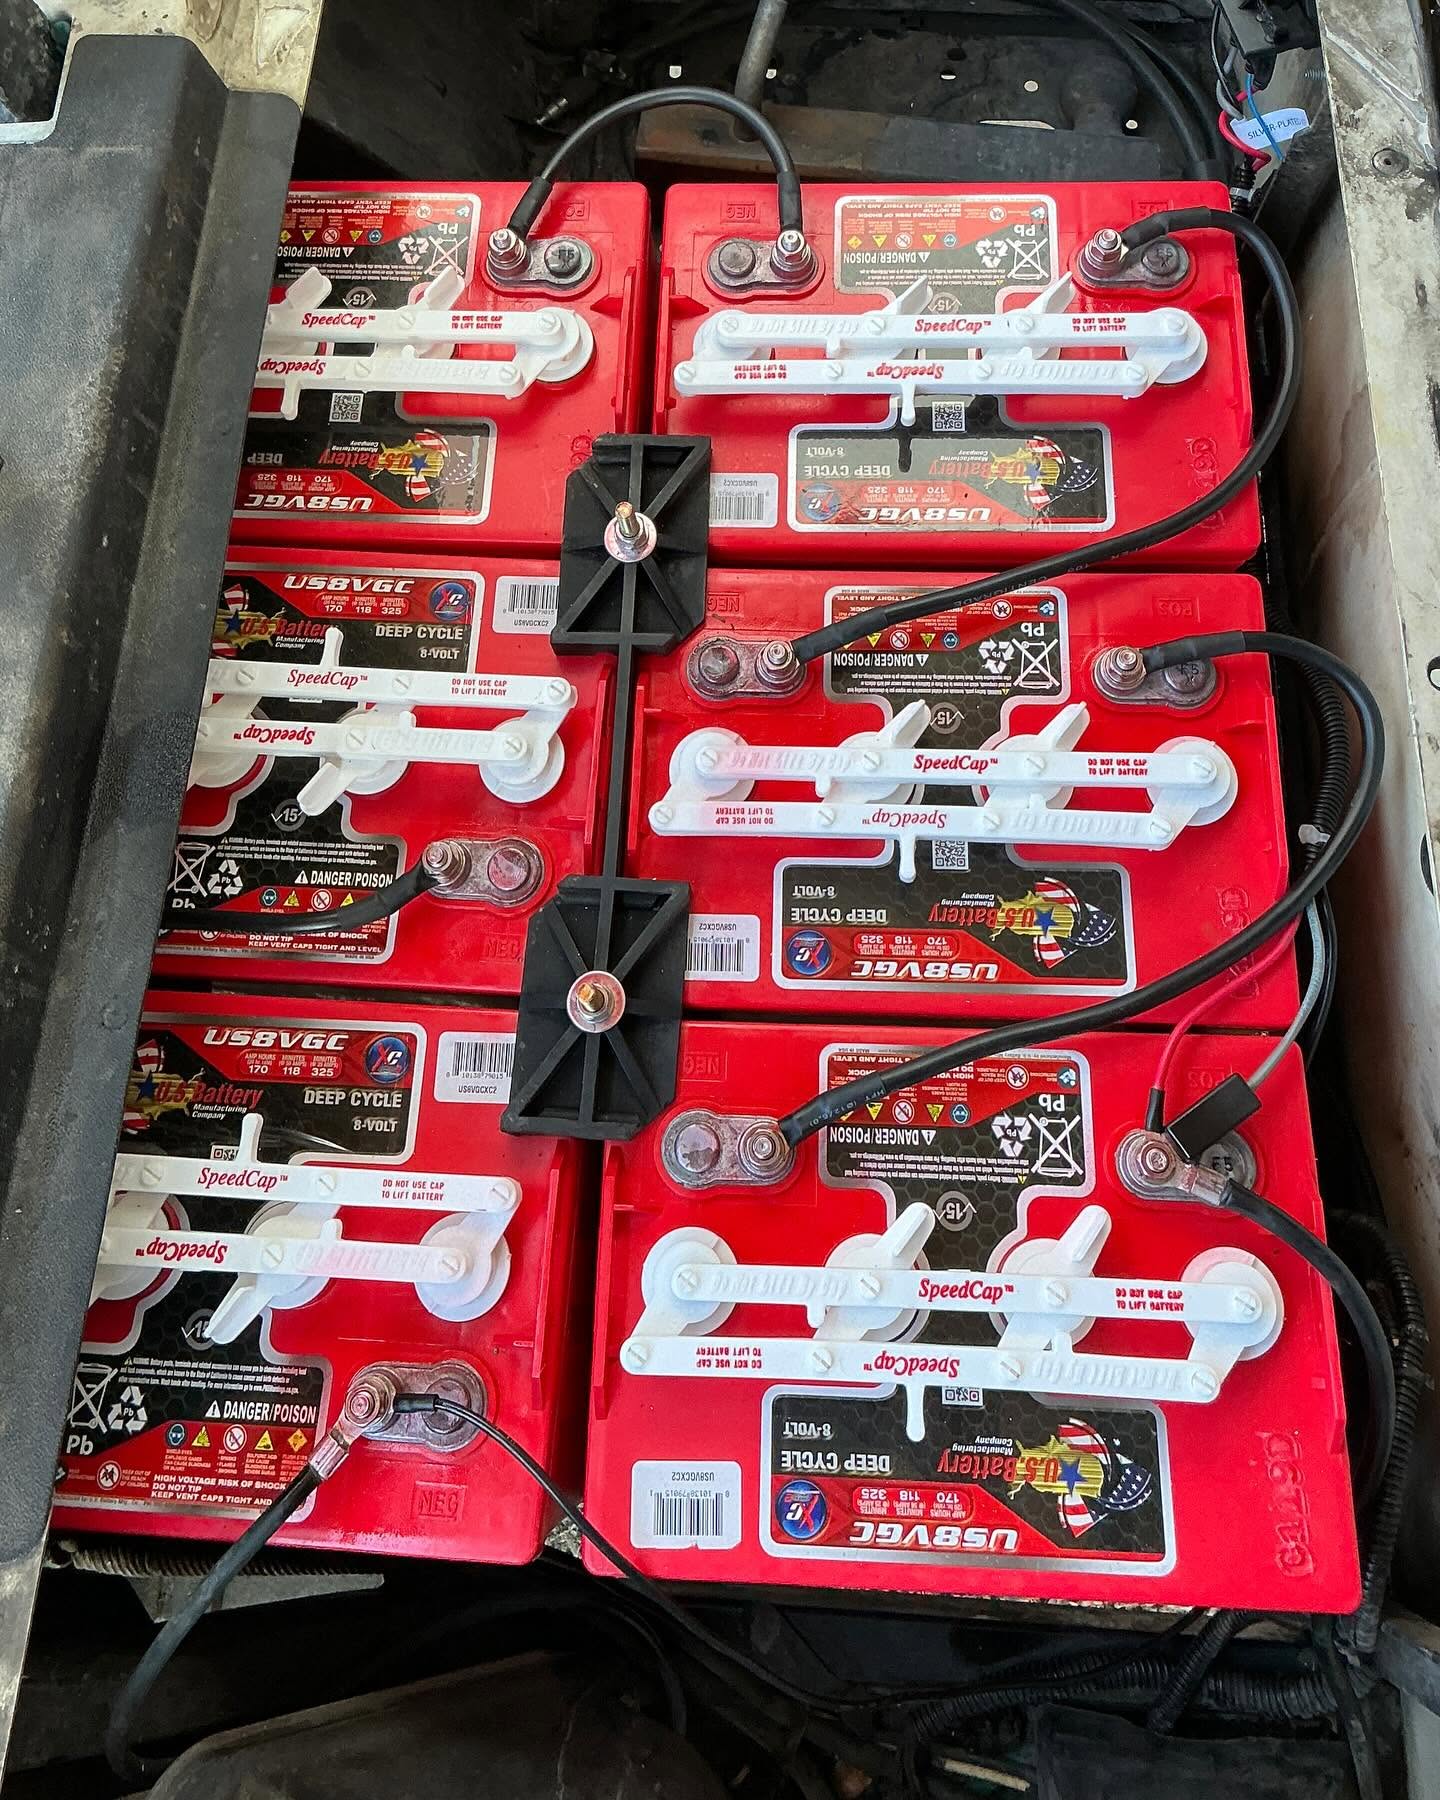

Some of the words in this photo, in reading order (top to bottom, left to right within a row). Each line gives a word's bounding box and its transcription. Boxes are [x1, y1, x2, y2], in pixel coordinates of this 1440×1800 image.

[438, 223, 458, 234] Pb
[1014, 224, 1035, 236] Pb
[277, 246, 340, 256] DANGER/POISO
[843, 251, 916, 263] DANGER/POISON
[353, 294, 365, 305] 15
[805, 446, 845, 457] 8-VOLT
[247, 452, 283, 465] DEEP
[318, 449, 379, 469] Battery
[804, 465, 849, 476] CYCLE
[854, 465, 890, 477] DEEP
[928, 459, 990, 477] Battery
[315, 475, 332, 483] 170
[244, 494, 372, 510] US8VGC
[857, 507, 991, 520] US8VGC
[284, 575, 415, 594] US8VGC
[325, 605, 343, 613] 170
[355, 606, 371, 614] 118
[382, 607, 402, 615] 325
[707, 597, 740, 612] NEG
[1158, 601, 1192, 616] POS
[376, 625, 414, 637] DEEP
[416, 627, 462, 640] CYCLE
[1020, 622, 1044, 636] Pb
[276, 636, 324, 645] Manufacturing
[420, 648, 460, 659] 8-VOLT
[834, 653, 913, 666] DANGER/POISON
[715, 807, 745, 815] BATTERY
[793, 885, 835, 897] 8-VOLT
[961, 892, 994, 900] Company
[941, 899, 994, 907] Manufacturing
[791, 907, 841, 922] CYCLE
[845, 908, 886, 923] DEEP
[928, 905, 998, 927] Battery
[861, 935, 883, 944] 325
[895, 936, 912, 944] 118
[927, 936, 947, 945] 170
[851, 960, 998, 980] US8VGC
[203, 1029, 350, 1050] US8VGC
[249, 1065, 268, 1074] 170
[282, 1066, 301, 1075] 118
[311, 1068, 334, 1077] 325
[192, 1082, 264, 1108] Battery
[304, 1089, 346, 1105] DEEP
[350, 1090, 402, 1108] CYCLE
[1038, 1093, 1065, 1111] Pb
[193, 1104, 247, 1114] Manufacturing
[192, 1111, 226, 1120] Company
[354, 1119, 398, 1132] 8-VOLT
[830, 1127, 919, 1144] DANGER/POISON
[395, 1180, 409, 1188] NOT
[412, 1181, 426, 1189] USE
[430, 1182, 444, 1190] CAP
[393, 1191, 409, 1200] LIFT
[412, 1192, 444, 1201] BATTERY
[945, 1202, 960, 1219] 15
[696, 1346, 729, 1356] BATTERY
[732, 1347, 750, 1356] LIFT
[752, 1348, 762, 1356] TO
[696, 1358, 711, 1368] CAP
[715, 1358, 730, 1368] USE
[734, 1359, 749, 1368] NOT
[752, 1359, 762, 1369] DO
[223, 1401, 317, 1425] DANGER/POISON
[783, 1421, 831, 1438] 8-VOLT
[66, 1434, 94, 1456] Pb
[975, 1435, 1013, 1447] Company
[952, 1443, 1013, 1456] Manufacturing
[781, 1450, 838, 1470] CYCLE
[844, 1454, 890, 1472] DEEP
[936, 1448, 1017, 1483] Battery
[154, 1474, 178, 1482] HIGH
[180, 1475, 216, 1485] VOLTAGE
[218, 1478, 239, 1486] RISK
[241, 1480, 253, 1488] OF
[255, 1481, 286, 1490] SHOCK
[671, 1472, 714, 1481] US8VGCXC2
[153, 1483, 165, 1491] DO
[167, 1484, 186, 1492] NOT
[151, 1491, 174, 1499] KEEP
[201, 1494, 224, 1502] CAPS
[226, 1496, 252, 1504] TIGHT
[254, 1498, 272, 1506] AND
[861, 1488, 887, 1500] 325
[900, 1490, 920, 1502] 118
[937, 1492, 960, 1504] 170
[419, 1491, 459, 1514] NEG
[860, 1506, 888, 1514] MINUTES
[896, 1508, 923, 1516] MINUTES
[930, 1509, 950, 1517] HOURS
[952, 1510, 966, 1518] AMP
[849, 1521, 1018, 1550] US8VGC
